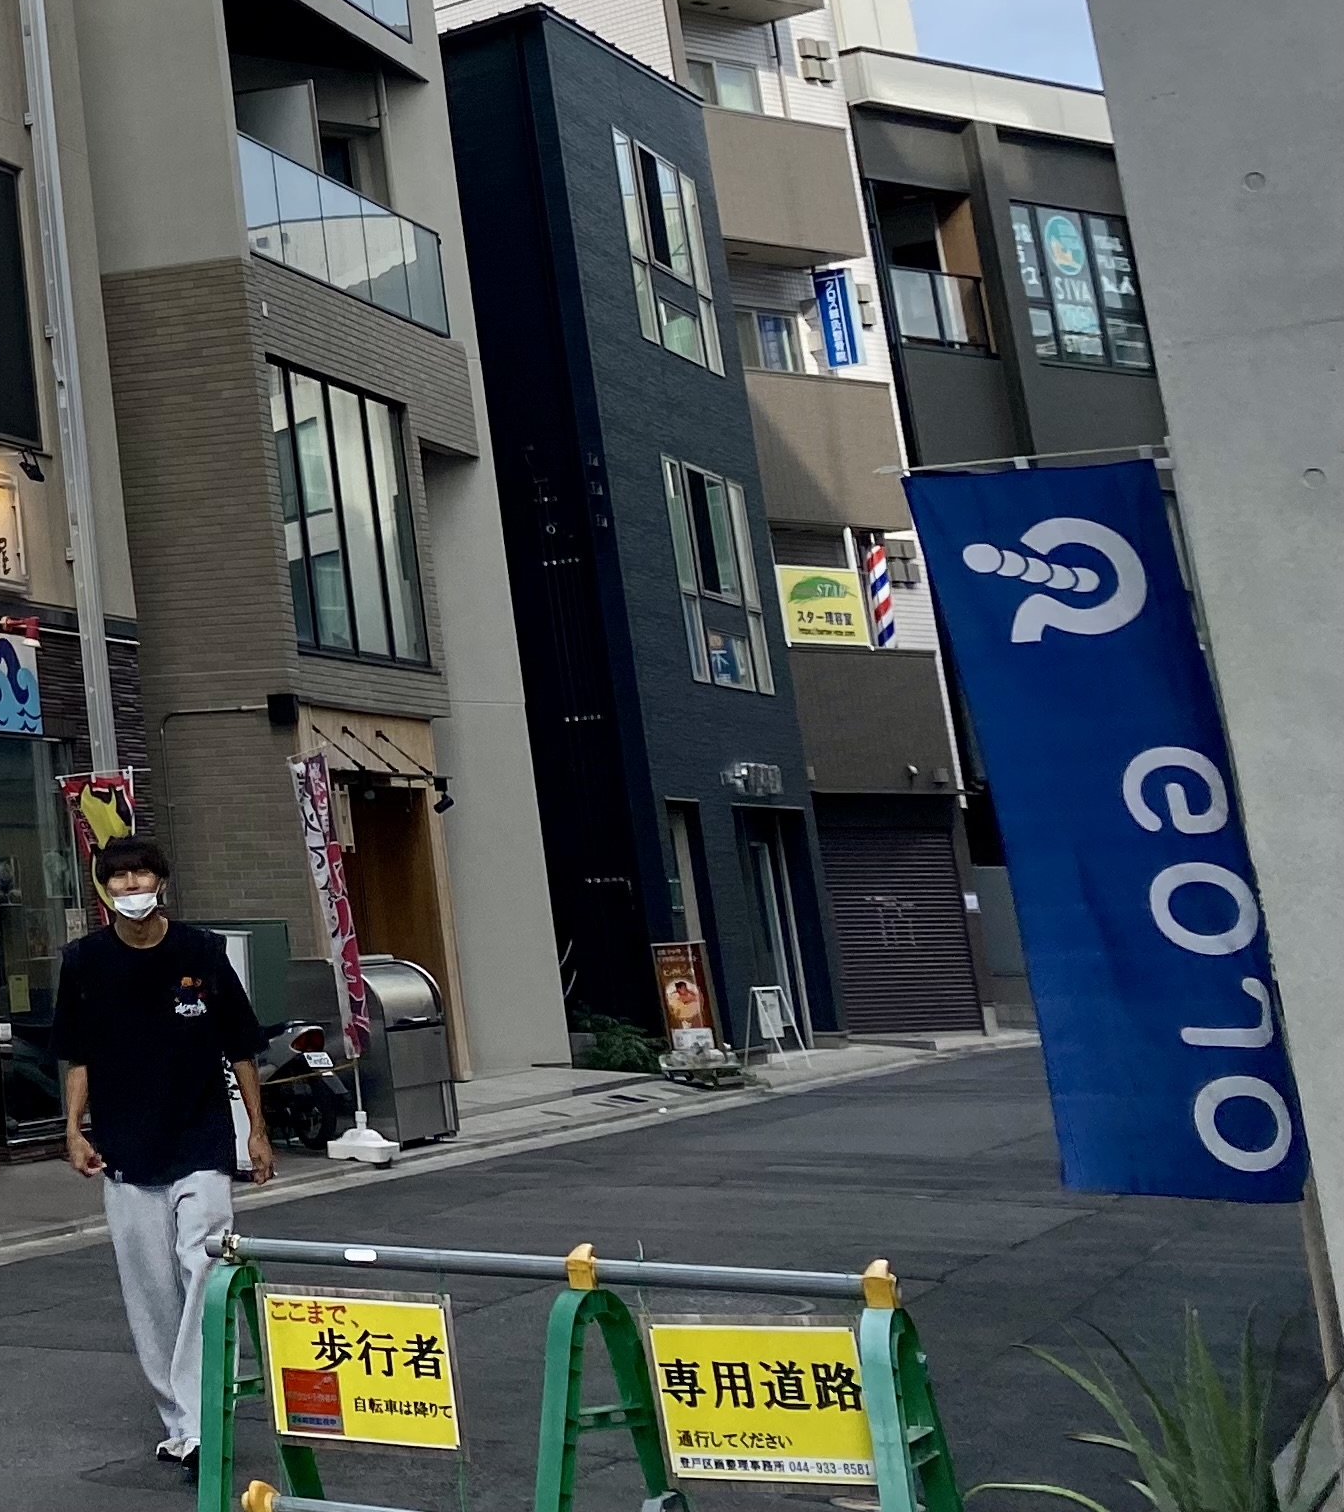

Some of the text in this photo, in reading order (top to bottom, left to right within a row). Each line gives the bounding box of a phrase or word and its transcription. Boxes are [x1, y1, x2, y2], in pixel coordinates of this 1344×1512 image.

[311, 1327, 445, 1380] 歩行者
[658, 1357, 863, 1412] 専用道路
[353, 1396, 454, 1419] 自転車は降りて
[676, 1429, 793, 1450] 通行してください
